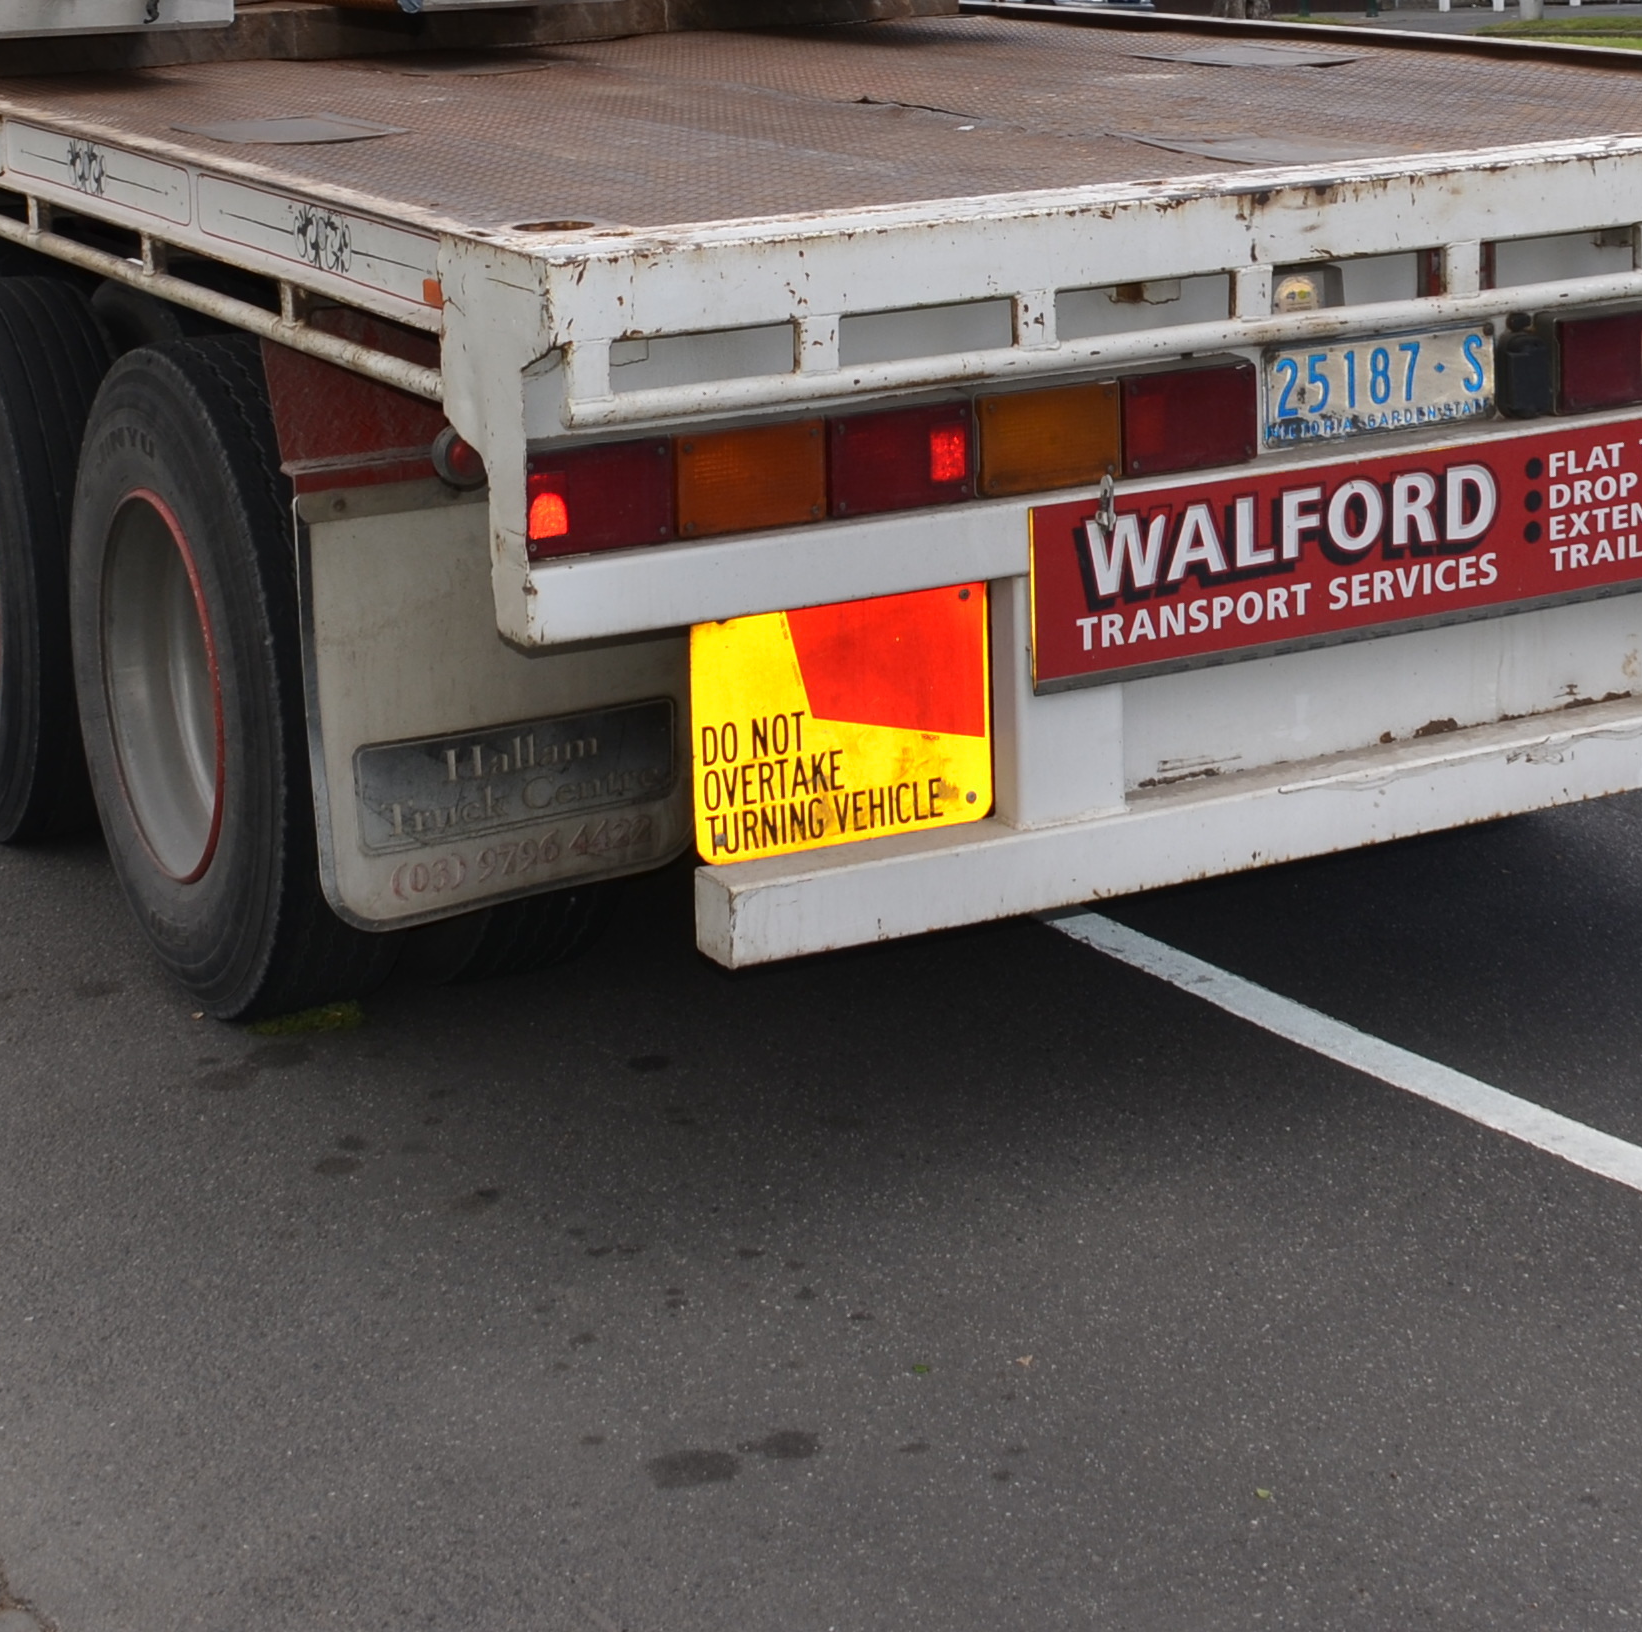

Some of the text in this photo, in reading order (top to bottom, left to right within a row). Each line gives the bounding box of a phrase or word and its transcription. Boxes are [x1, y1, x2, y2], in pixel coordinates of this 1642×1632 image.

[1275, 333, 1485, 419] 25187 S
[1367, 406, 1437, 430] GARDEN
[1548, 442, 1625, 478] FLAT
[1548, 471, 1638, 510] DROP
[1083, 463, 1498, 598] WALFORD
[1075, 552, 1499, 651] TRANSPORT SERVICES
[443, 732, 599, 784] Hallam
[701, 710, 805, 767] DO NOT
[379, 764, 659, 837] Truck Centre
[703, 749, 845, 811] OVERTAKE
[704, 776, 945, 857] TURNING VEHICLE
[389, 814, 653, 901] (03) 9796 4422
